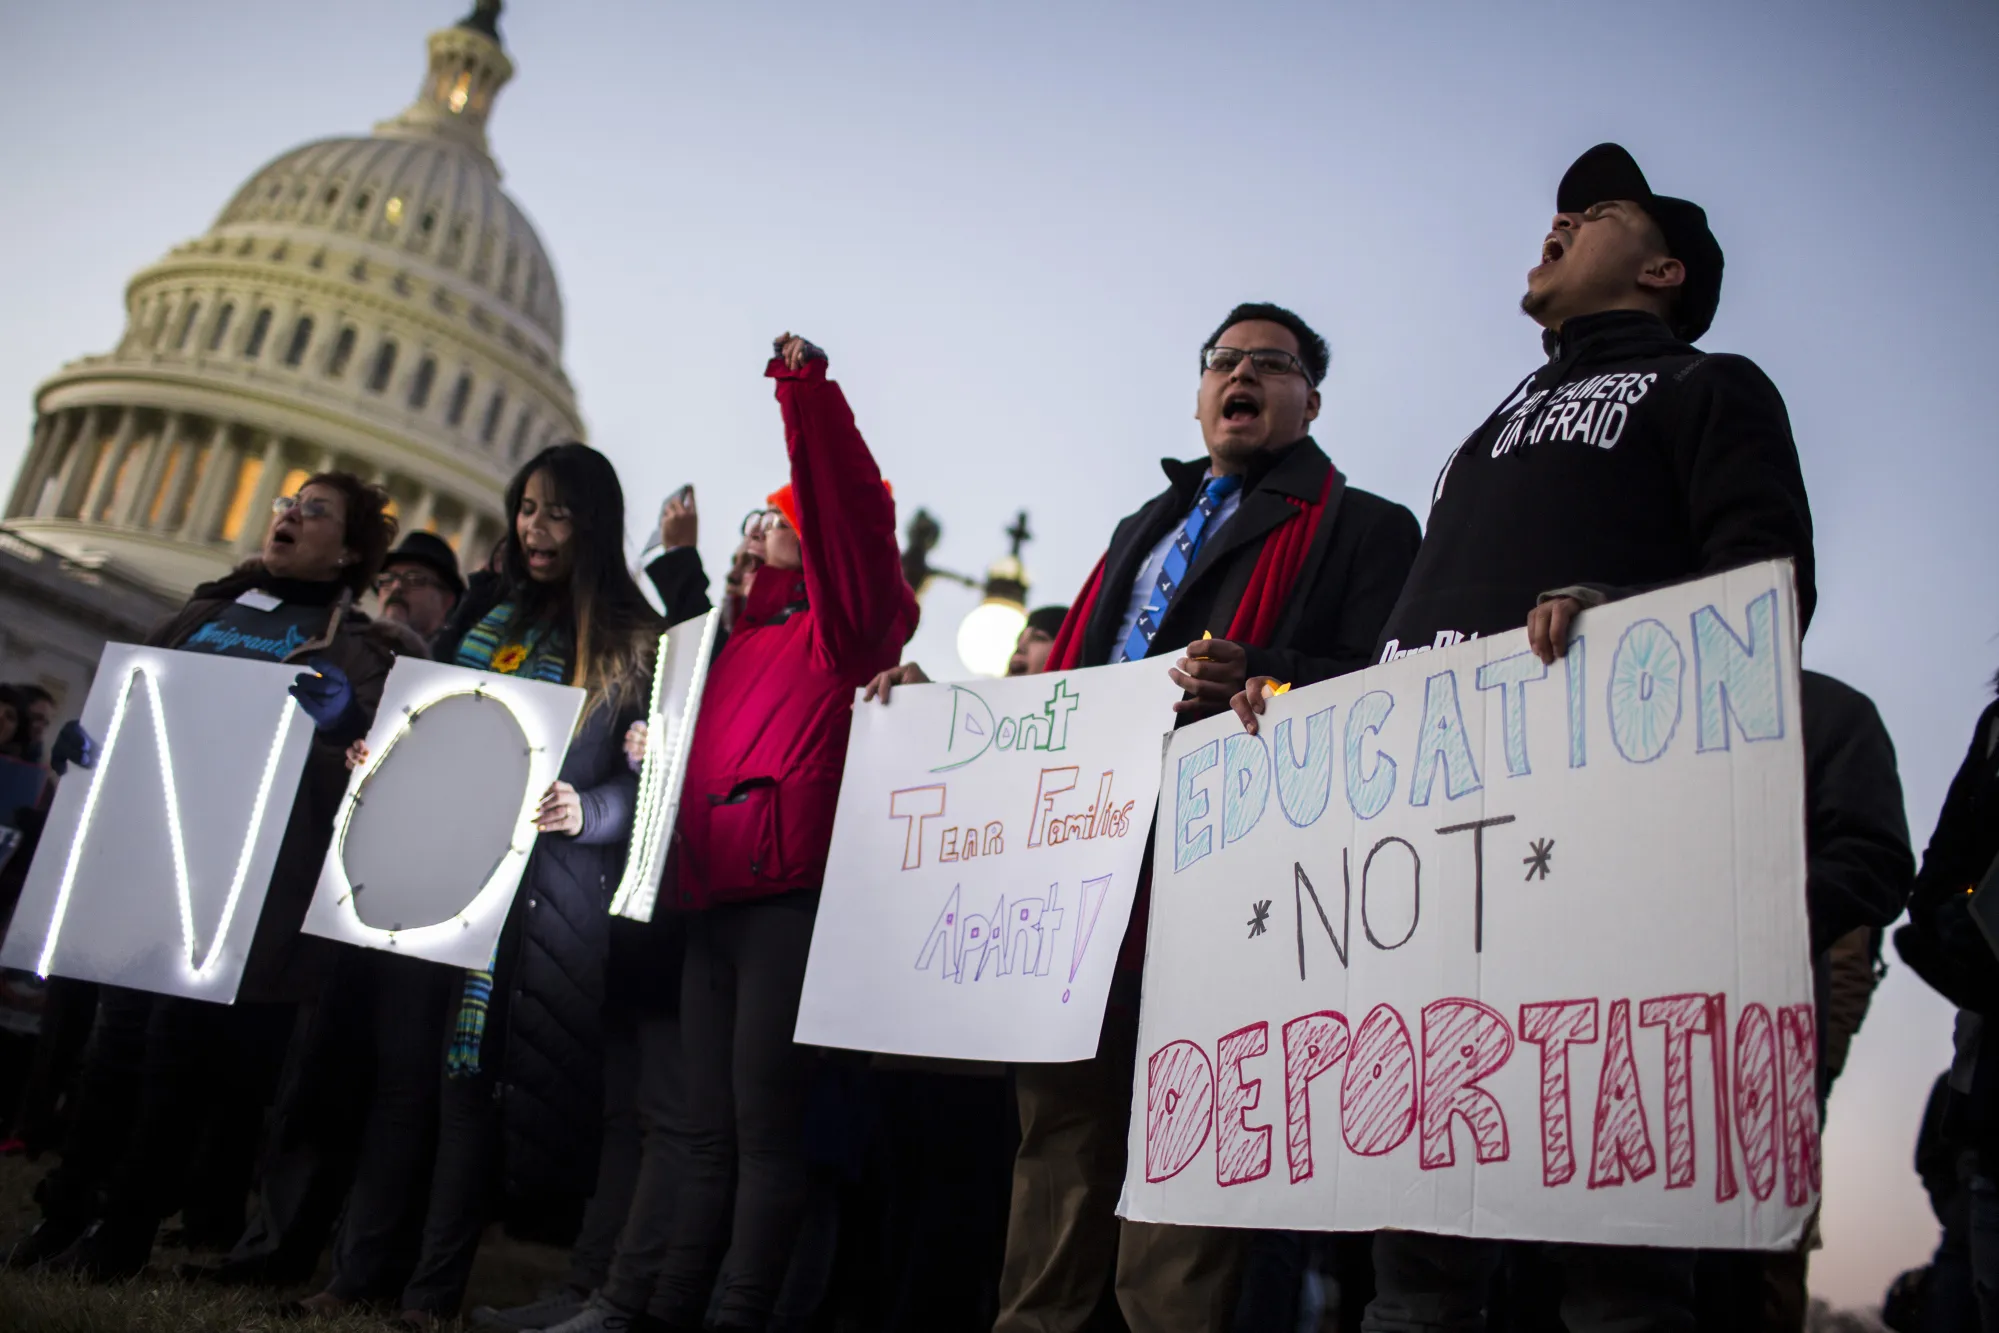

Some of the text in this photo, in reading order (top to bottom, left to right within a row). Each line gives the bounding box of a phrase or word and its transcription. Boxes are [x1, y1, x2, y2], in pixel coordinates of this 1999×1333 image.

[930, 678, 1080, 773] Dont
[1173, 588, 1785, 874] EDUCATION
[889, 766, 1135, 871] TEAR Families
[1146, 992, 1822, 1207] DEPORTATION
